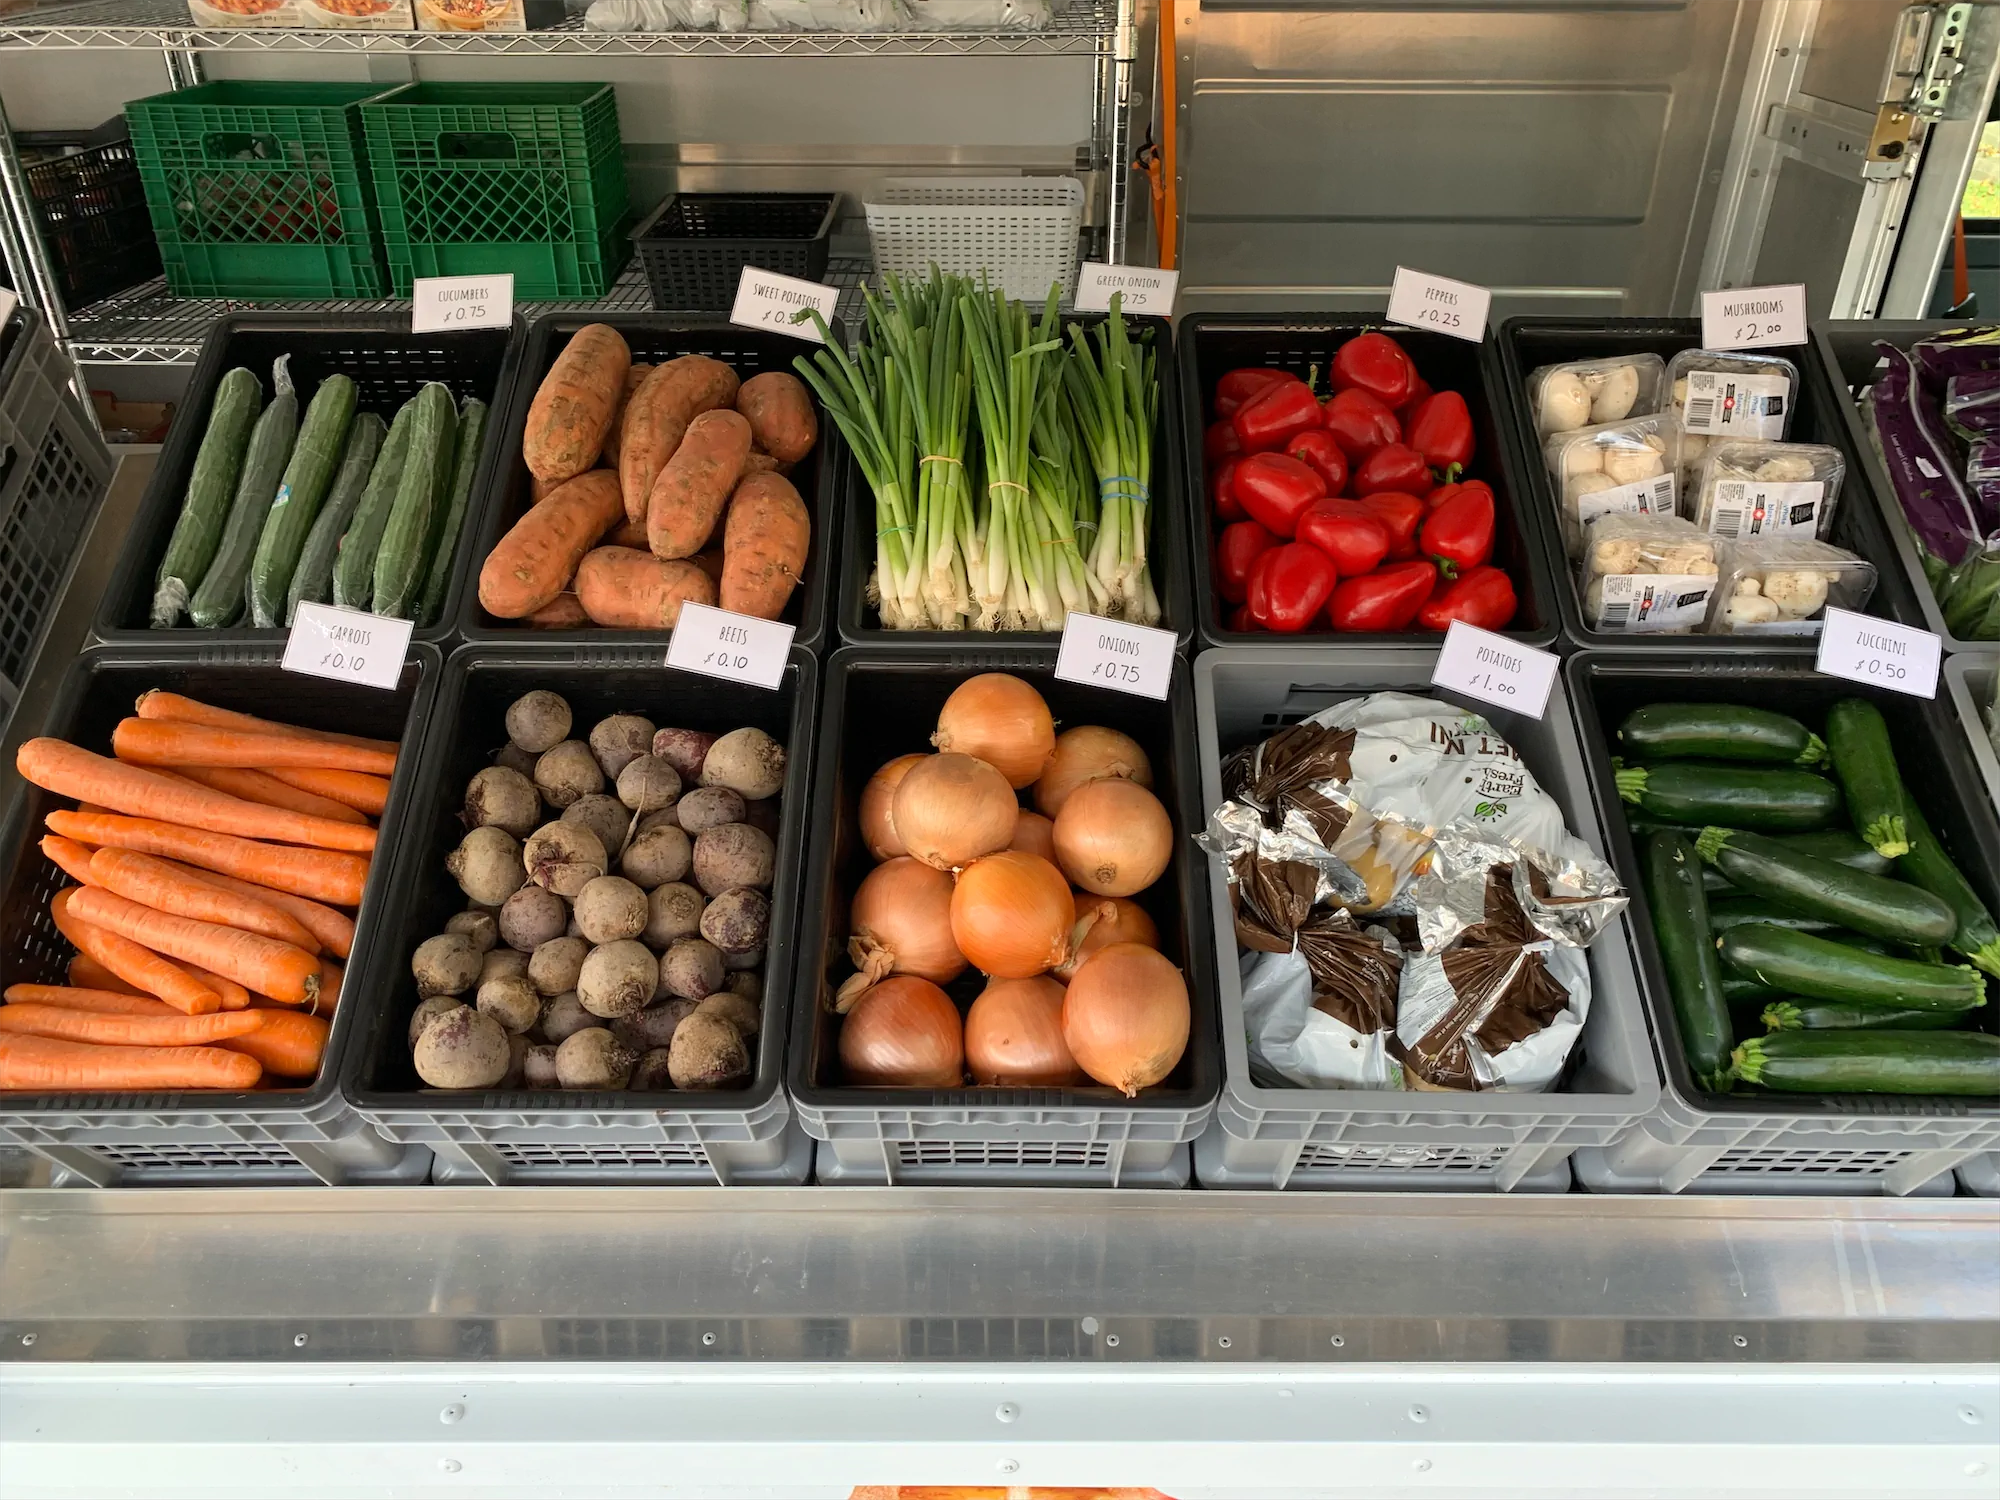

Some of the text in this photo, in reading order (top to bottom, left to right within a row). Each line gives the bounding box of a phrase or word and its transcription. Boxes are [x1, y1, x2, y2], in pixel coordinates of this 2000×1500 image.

[1096, 275, 1161, 289] GREEN ONION
[438, 288, 489, 302] CUCUMBERS
[753, 283, 821, 310] SWEET POTATOES
[1106, 292, 1147, 305] 0.75
[1425, 287, 1459, 306] PEPPERS
[1723, 300, 1784, 317] MUSHROOMS
[330, 625, 371, 646] CARROTS
[719, 626, 748, 645] BEETS
[1856, 631, 1907, 656] ZUCCHINI
[1098, 634, 1140, 657] ONIONS
[1476, 646, 1523, 674] POTATOES
